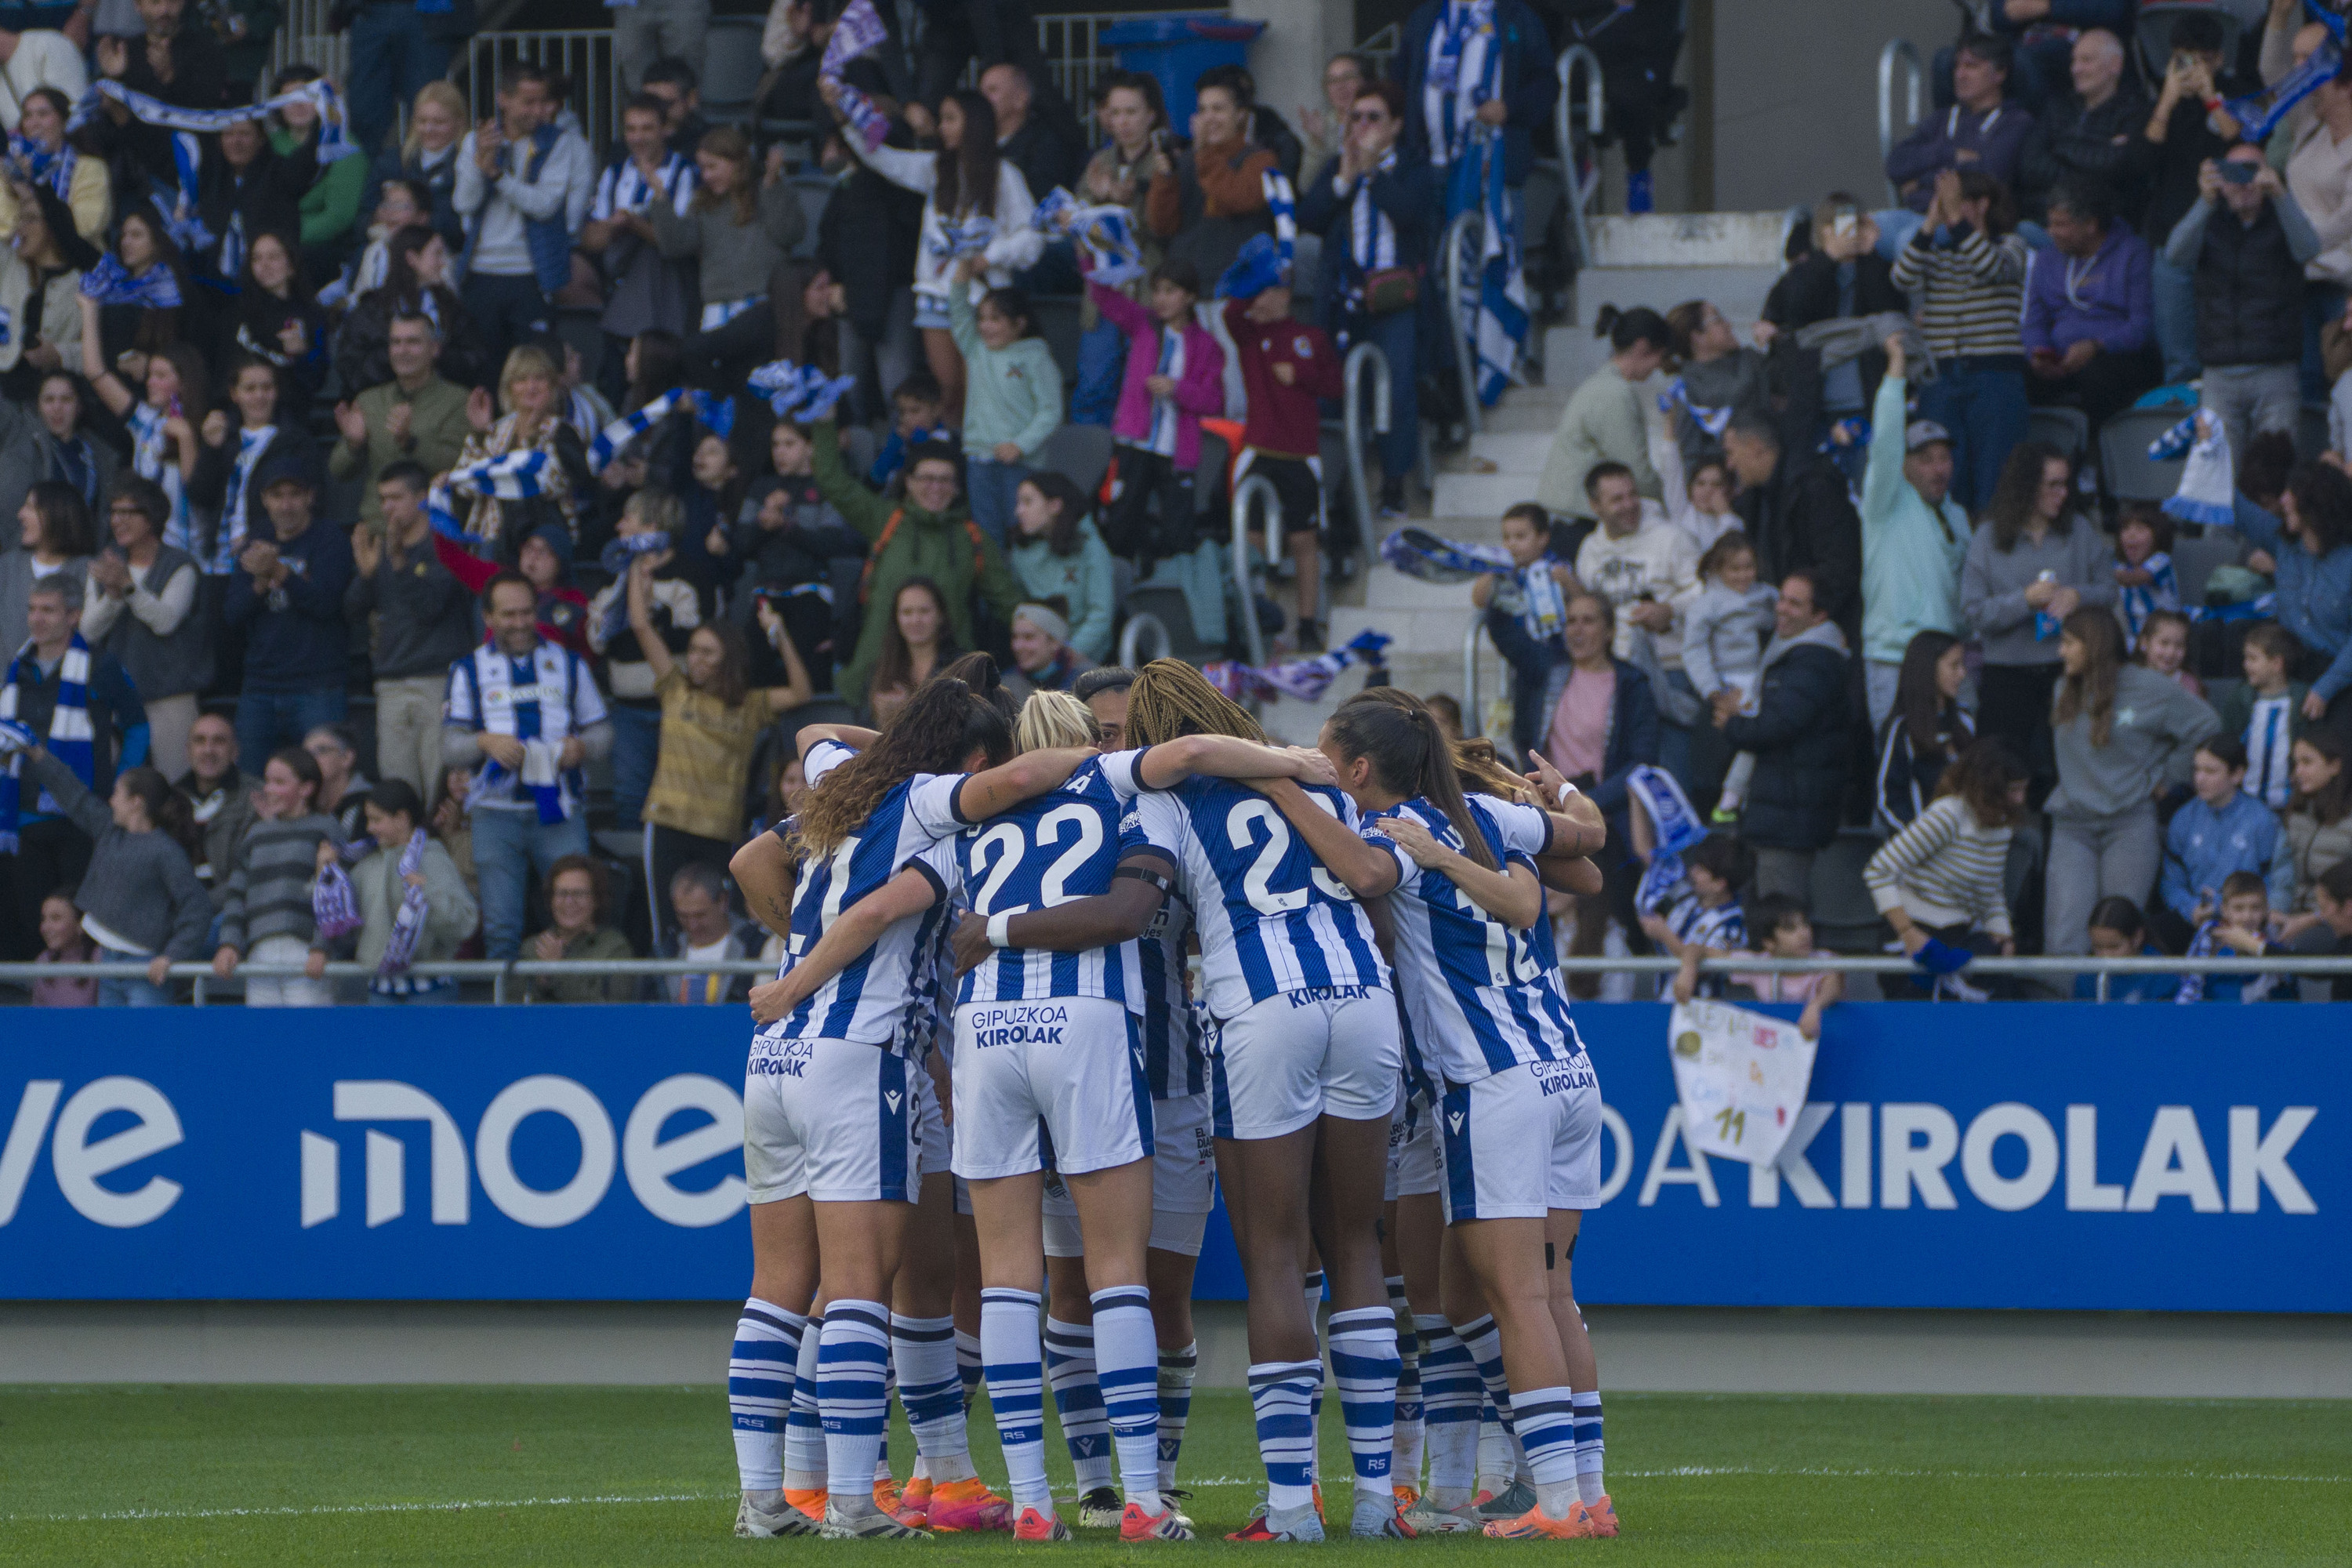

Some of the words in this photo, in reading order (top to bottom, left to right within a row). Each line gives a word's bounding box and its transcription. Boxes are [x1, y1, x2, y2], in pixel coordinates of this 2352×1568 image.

[969, 803, 1104, 917] 22
[1287, 985, 1371, 1010] KIROLAK
[971, 1006, 1068, 1029] GIPUZKOA
[975, 1025, 1064, 1050] KIROLAK
[747, 1057, 807, 1078] KIROLAK
[1539, 1072, 1597, 1097] KIROLAK
[1714, 1106, 1745, 1146] 11
[300, 1073, 746, 1229] moe
[1748, 1102, 2318, 1213] KIROLAK
[738, 1417, 765, 1428] RS
[1004, 1431, 1026, 1440] RS
[1302, 1467, 1312, 1479] R
[1368, 1459, 1386, 1470] RS
